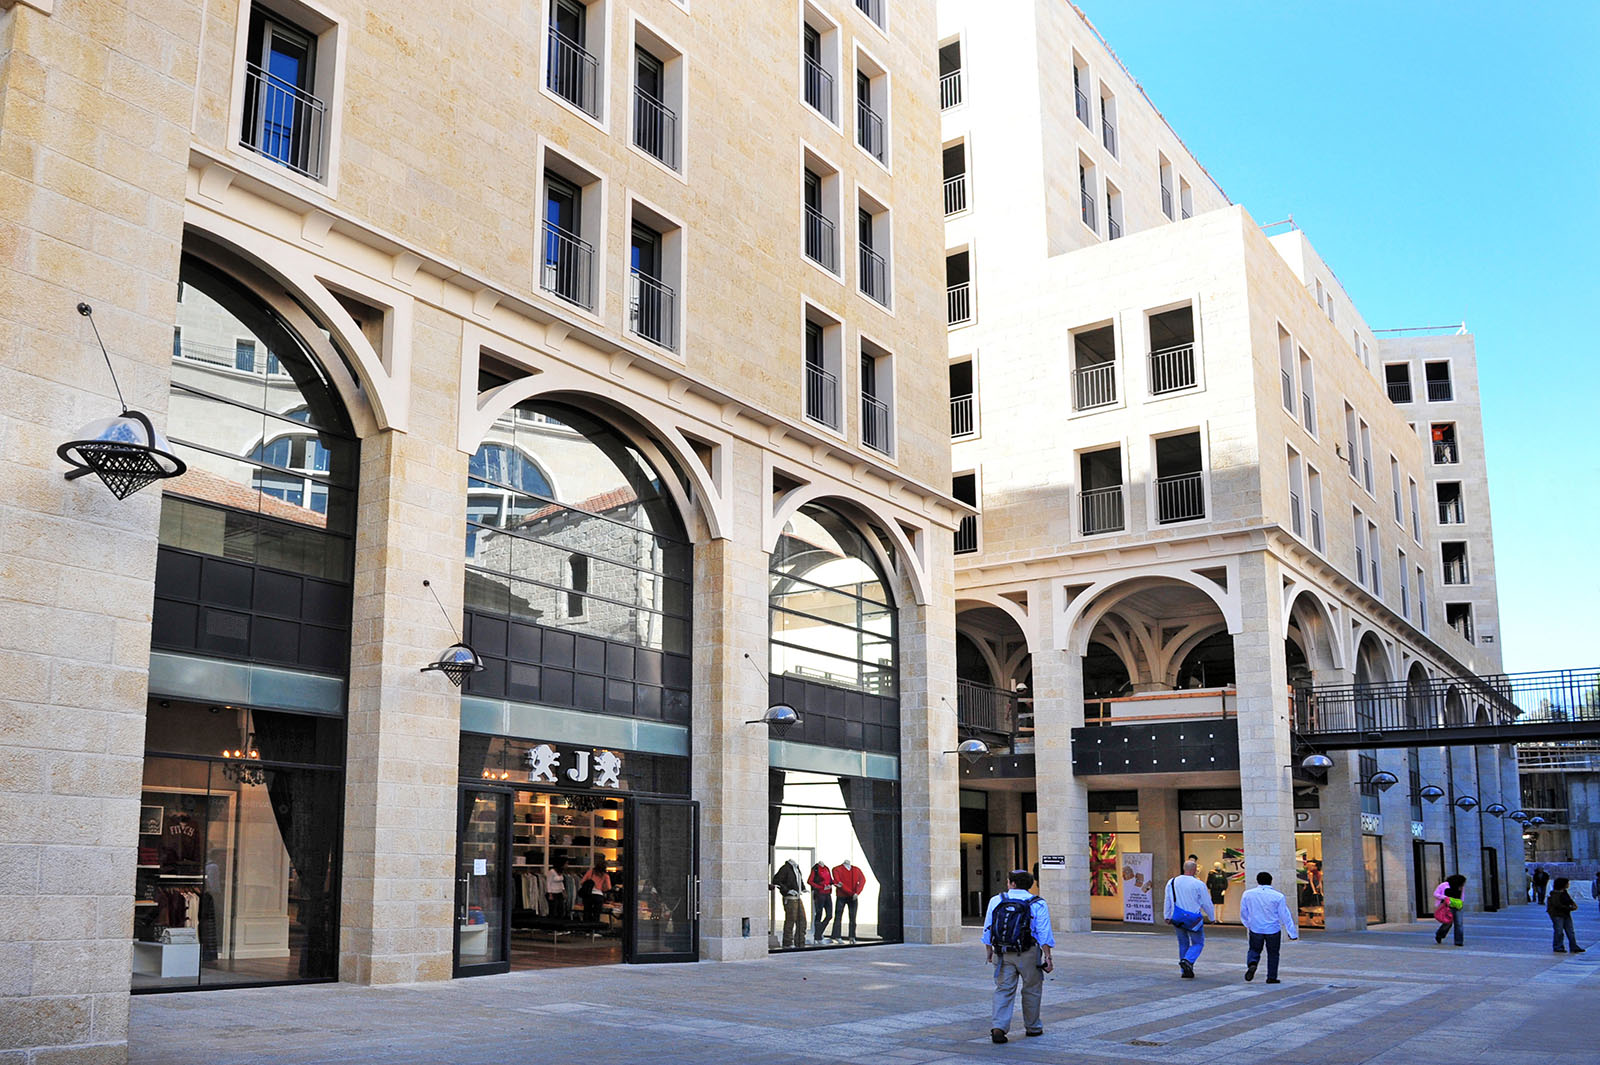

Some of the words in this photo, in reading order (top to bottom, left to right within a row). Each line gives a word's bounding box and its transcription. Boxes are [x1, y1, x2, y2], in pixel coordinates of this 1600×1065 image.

[566, 750, 591, 783] J
[1195, 812, 1311, 829] TOPP
[1126, 910, 1151, 921] miller
